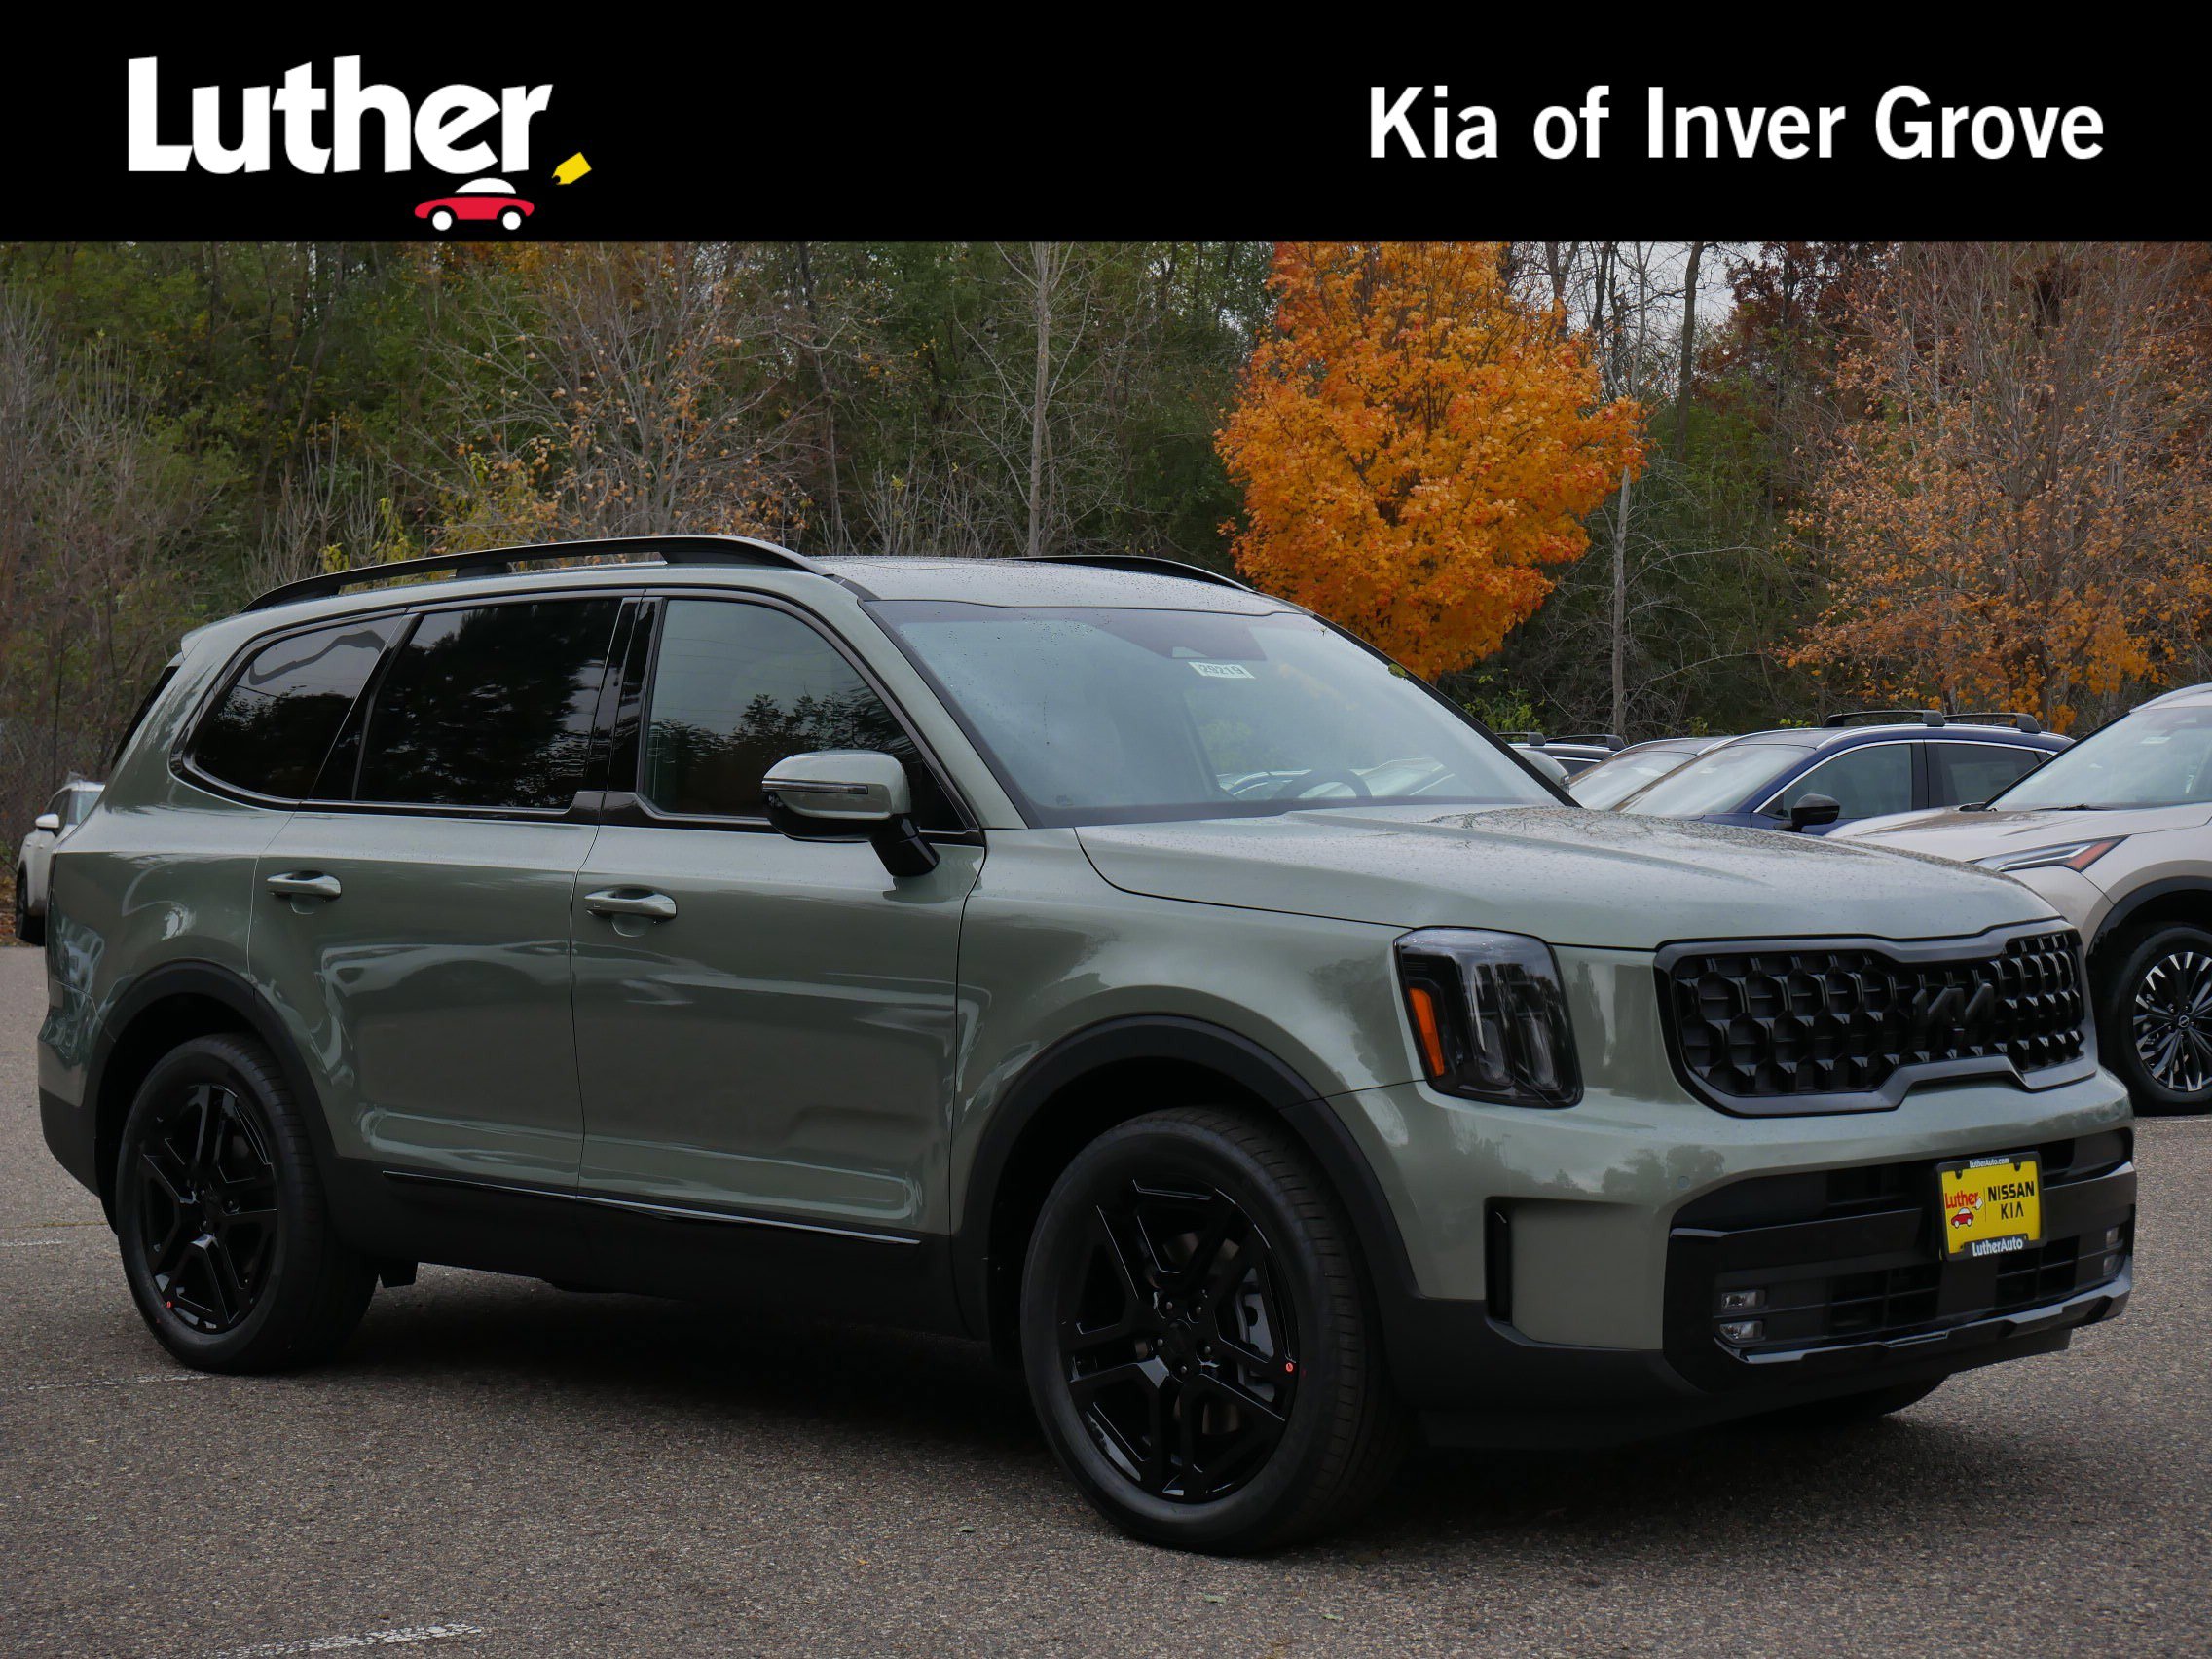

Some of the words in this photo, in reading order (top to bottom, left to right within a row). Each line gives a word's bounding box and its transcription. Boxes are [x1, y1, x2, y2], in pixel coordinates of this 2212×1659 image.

[1969, 1157, 2009, 1168] LutherAuto.com
[1944, 1191, 1979, 1209] Luther
[1987, 1181, 2035, 1202] NISSAN
[2000, 1201, 2024, 1220] KIA
[1972, 1236, 2023, 1257] LutherAuto
